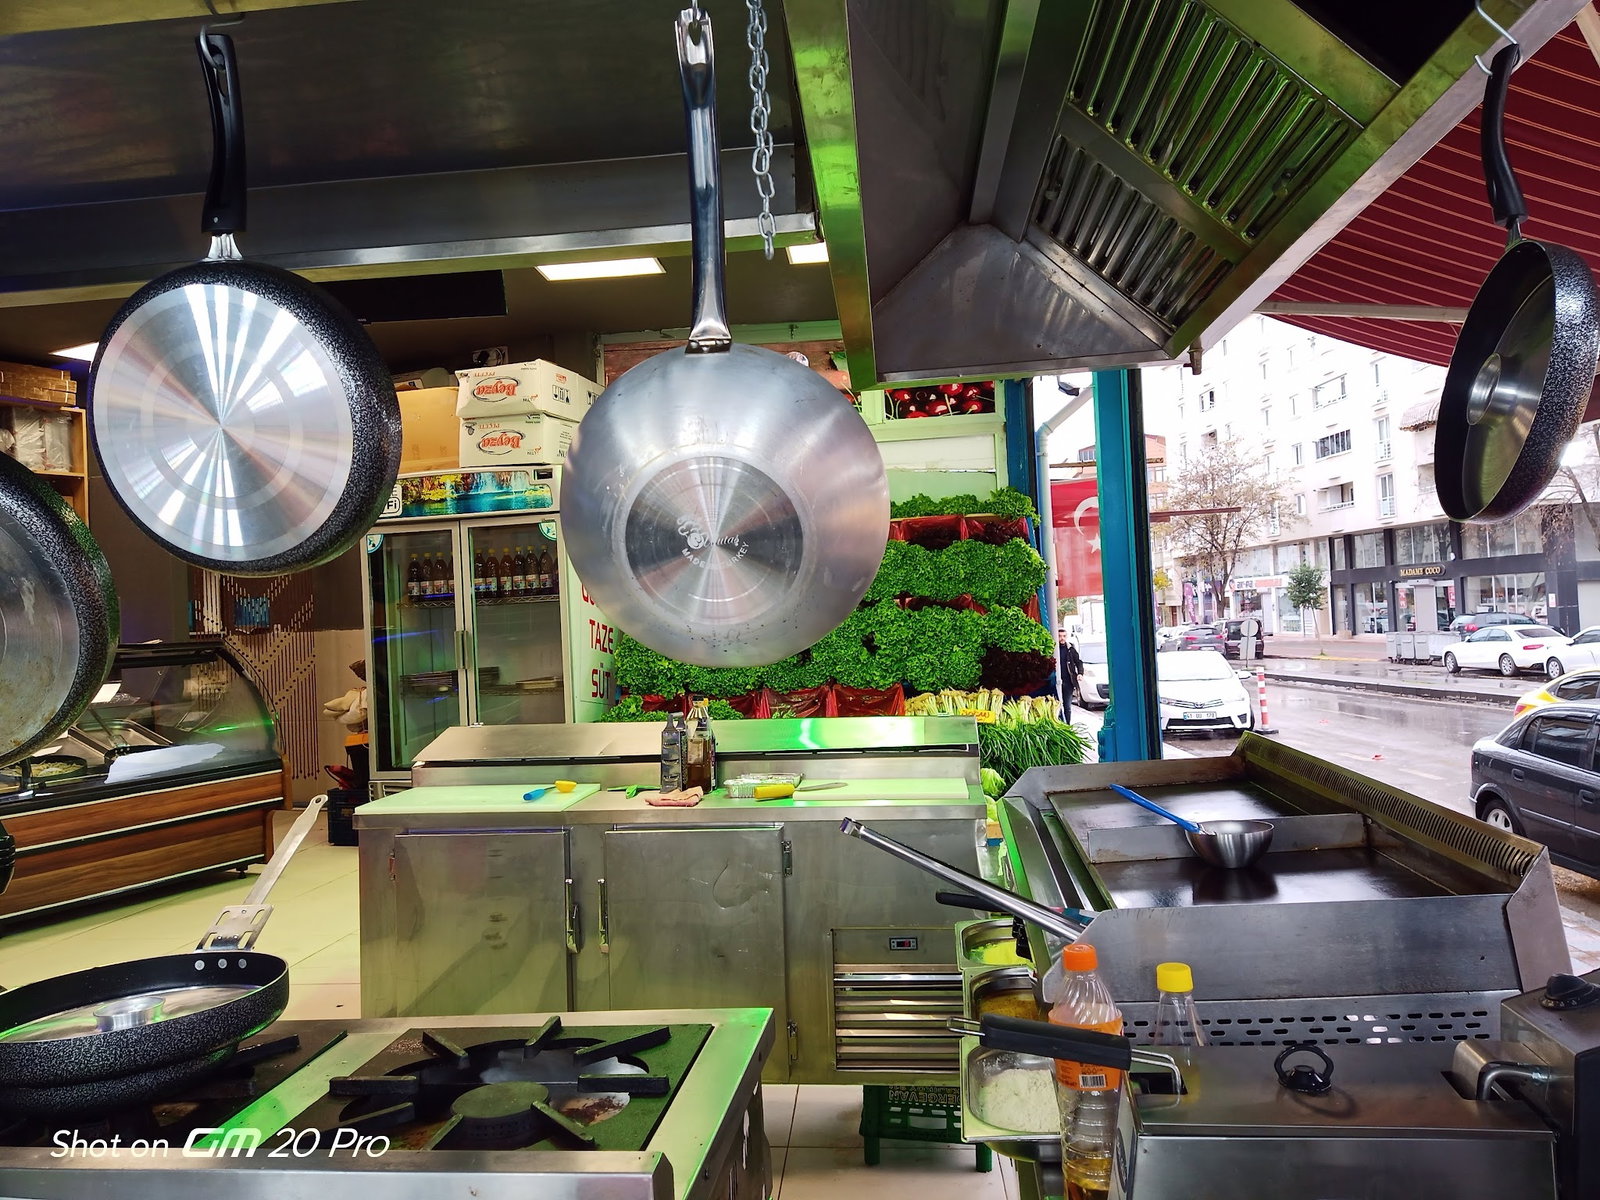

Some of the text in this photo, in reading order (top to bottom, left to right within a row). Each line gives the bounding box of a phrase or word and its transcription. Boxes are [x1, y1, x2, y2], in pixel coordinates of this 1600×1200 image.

[476, 380, 516, 396] Beyza
[481, 433, 520, 448] Beyza
[681, 548, 706, 568] MADE
[1425, 566, 1440, 575] COCO
[589, 619, 614, 654] TAZE
